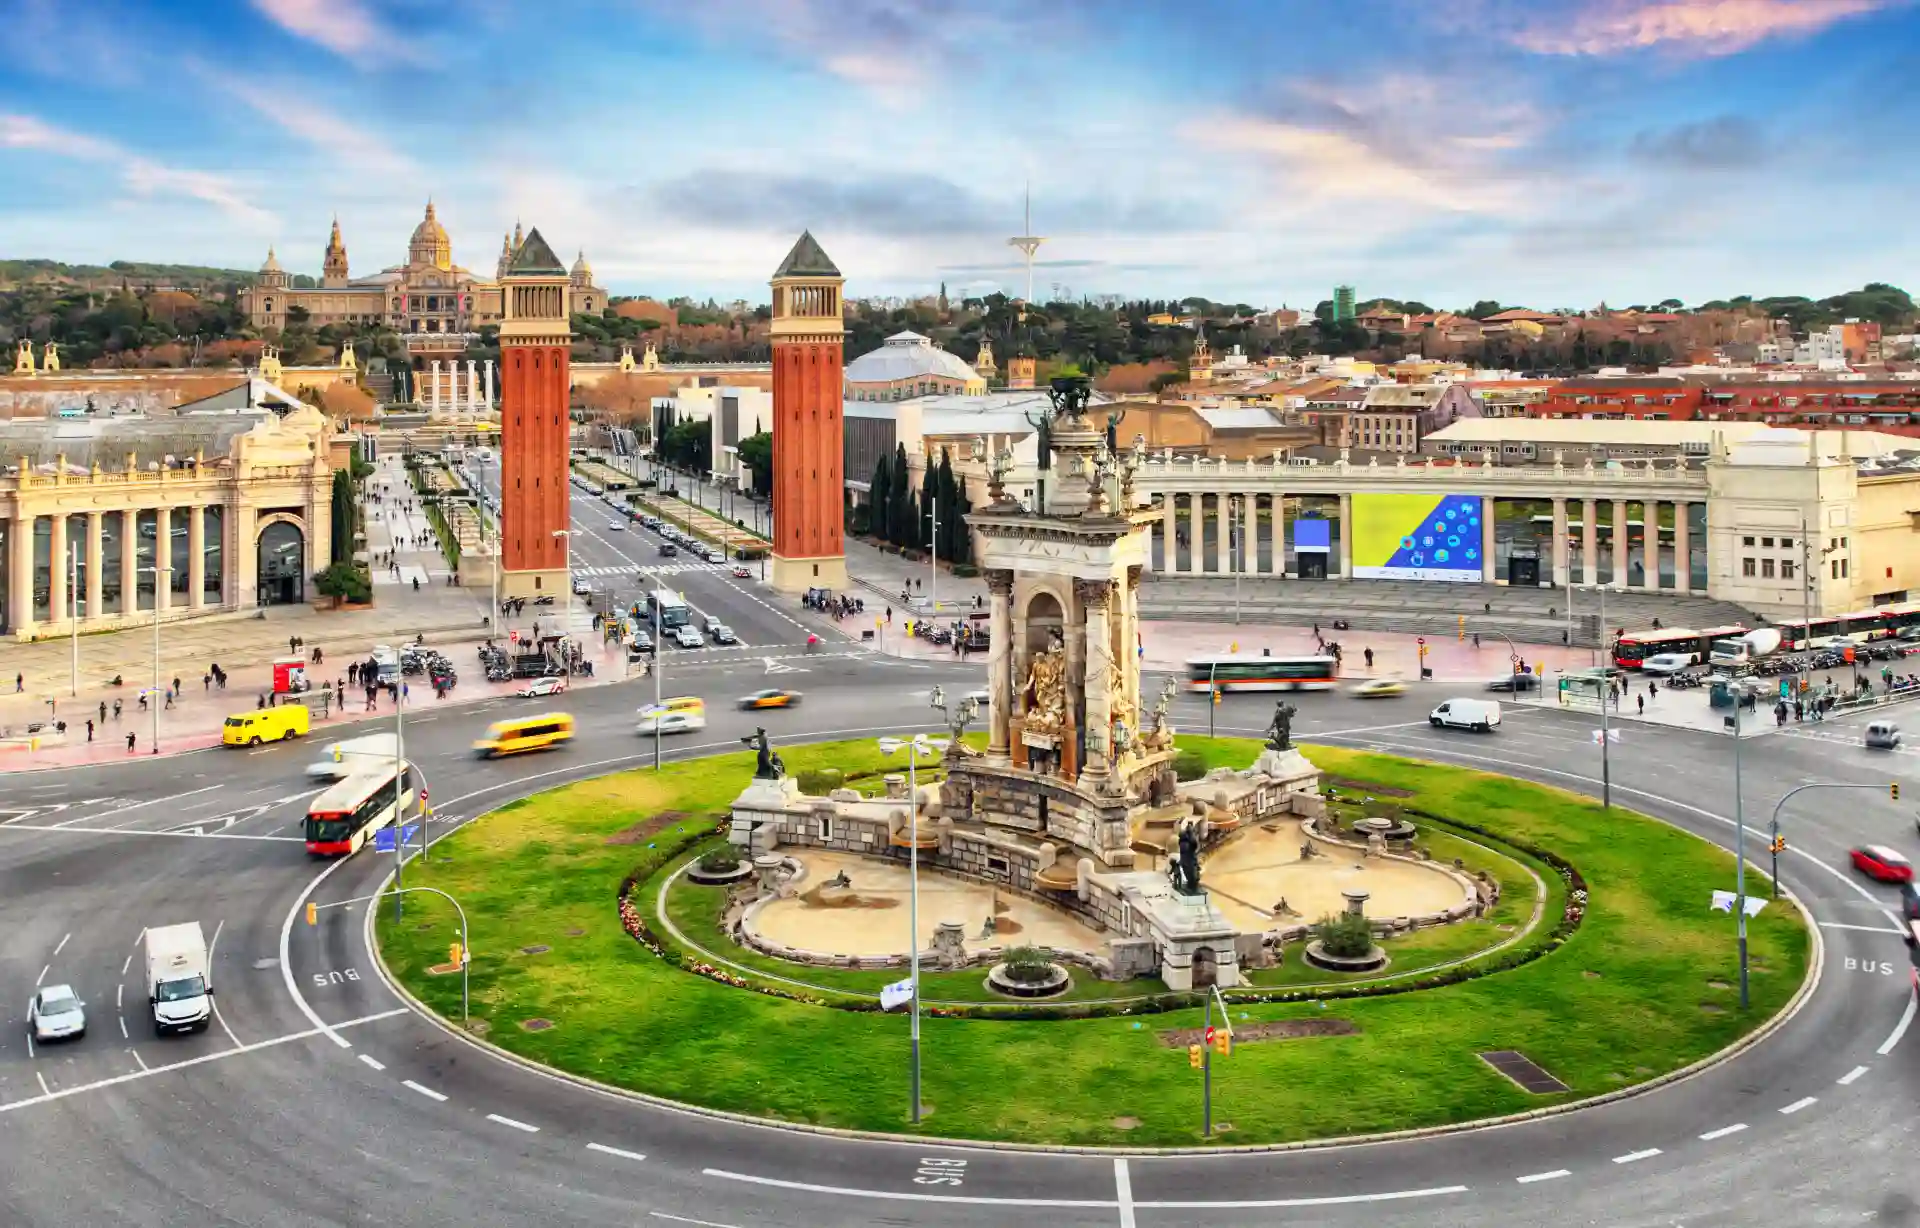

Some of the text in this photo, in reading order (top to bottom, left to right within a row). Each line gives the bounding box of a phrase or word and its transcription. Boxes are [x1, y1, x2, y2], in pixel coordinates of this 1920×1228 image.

[1844, 956, 1894, 976] BUS
[313, 968, 361, 987] BUS
[912, 1157, 968, 1186] BUS
